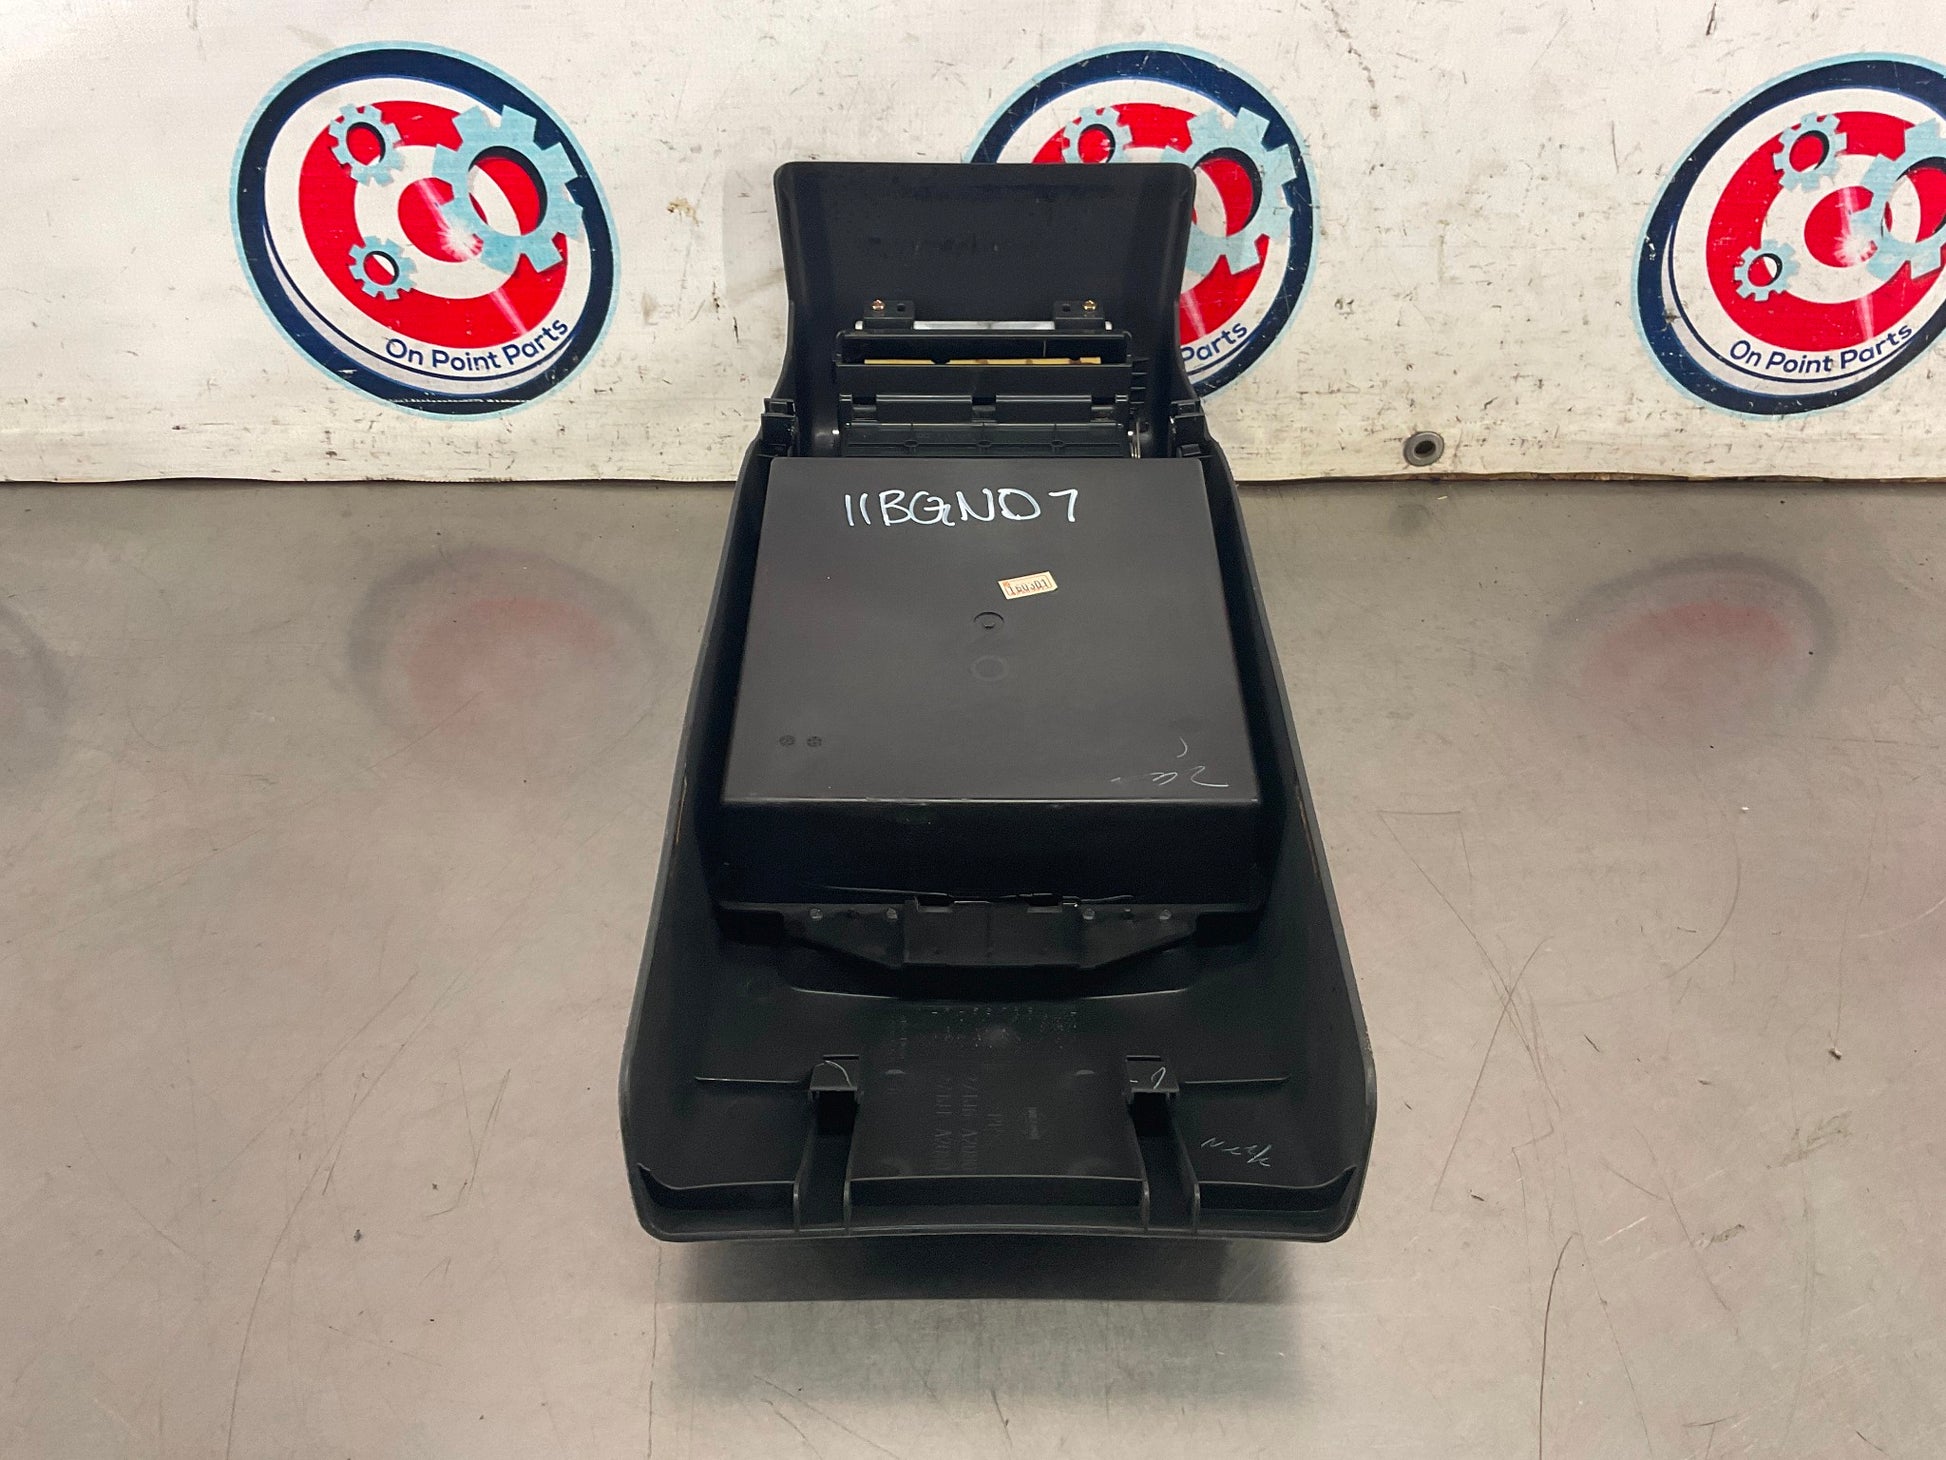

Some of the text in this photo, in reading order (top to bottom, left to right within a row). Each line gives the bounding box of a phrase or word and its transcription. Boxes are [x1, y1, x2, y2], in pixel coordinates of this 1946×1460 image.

[386, 319, 568, 371] On Point Parts
[1730, 324, 1913, 374] On Point Parts
